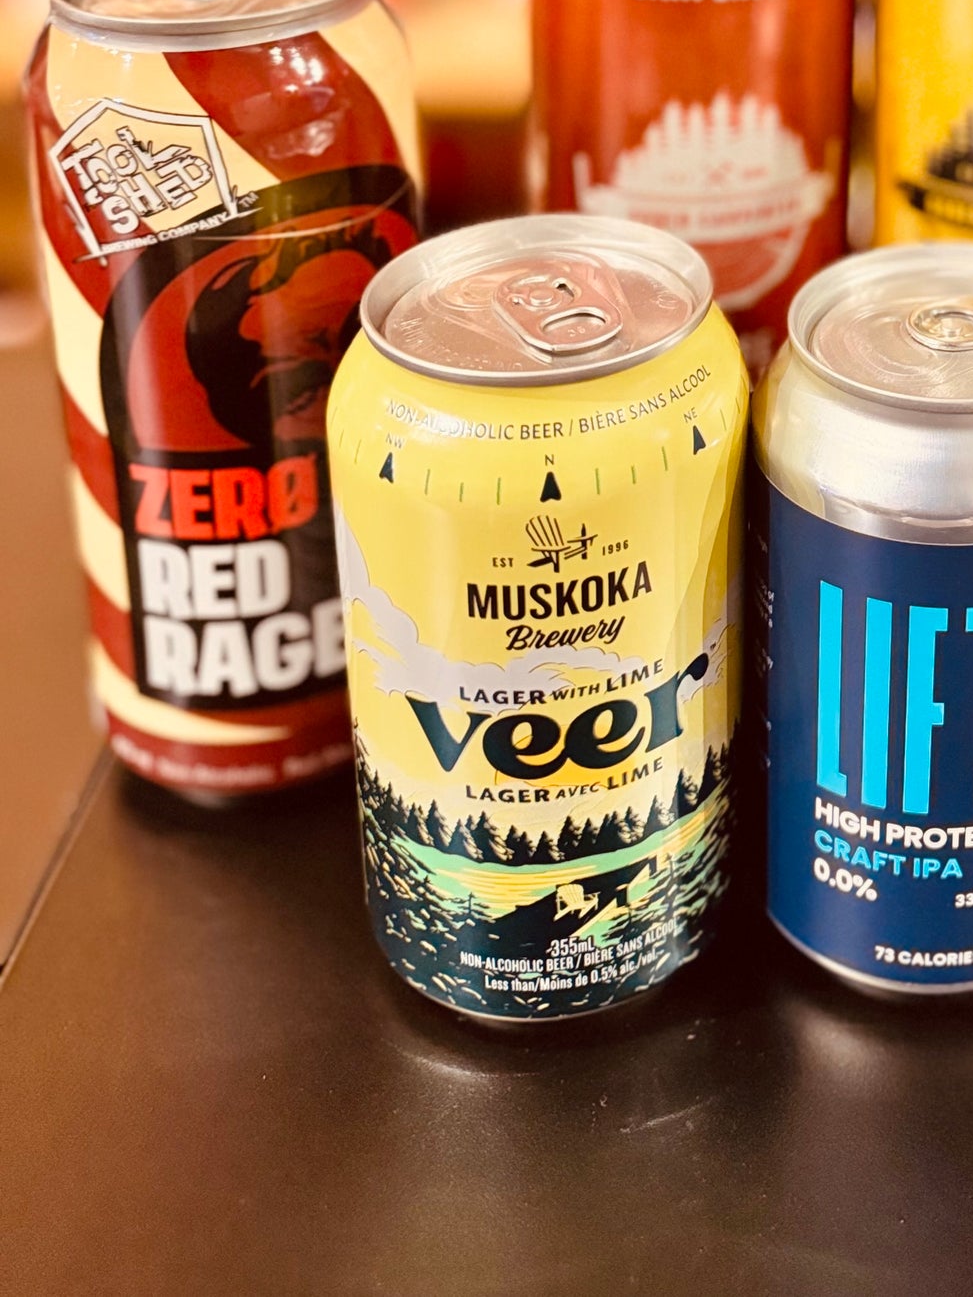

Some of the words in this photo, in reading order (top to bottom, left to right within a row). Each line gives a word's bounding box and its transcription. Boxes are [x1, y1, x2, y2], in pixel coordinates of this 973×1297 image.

[101, 154, 214, 234] SHED
[160, 212, 230, 242] COMPANY
[386, 399, 514, 440] NON-ALCOHOLIC
[520, 421, 564, 440] BEER
[579, 408, 626, 434] BIÈRE
[629, 395, 667, 422] SANS
[670, 364, 712, 404] ALCOOL
[683, 407, 699, 424] NE
[384, 433, 406, 450] NW
[544, 453, 555, 467] N
[491, 556, 515, 569] EST
[601, 539, 630, 556] 1996
[137, 539, 290, 621] RED
[467, 560, 653, 621] MUSKOKA
[144, 597, 346, 698] RAGE
[505, 615, 626, 651] Brewery
[458, 686, 547, 705] LAGER
[552, 684, 600, 702] WITH
[605, 658, 664, 694] LIME
[405, 652, 709, 780] veer
[465, 784, 551, 803] LAGER
[555, 781, 600, 800] AVEC
[606, 756, 664, 791] LIME
[814, 796, 881, 842] HIGH
[814, 829, 906, 876] CRAFT
[912, 858, 964, 880] IPA
[813, 856, 878, 901] 0.0%
[460, 950, 544, 973] NON-ALCOHOLIC
[546, 957, 574, 973] BEER
[583, 945, 614, 967] BIÈRE
[616, 937, 644, 958] SANS
[644, 917, 680, 946] ALCOOL
[549, 936, 595, 958] 355mL
[874, 945, 895, 963] 73
[484, 973, 510, 991] Less
[511, 975, 573, 993] than/Moins
[575, 974, 589, 988] de
[590, 964, 618, 984] 0.5%
